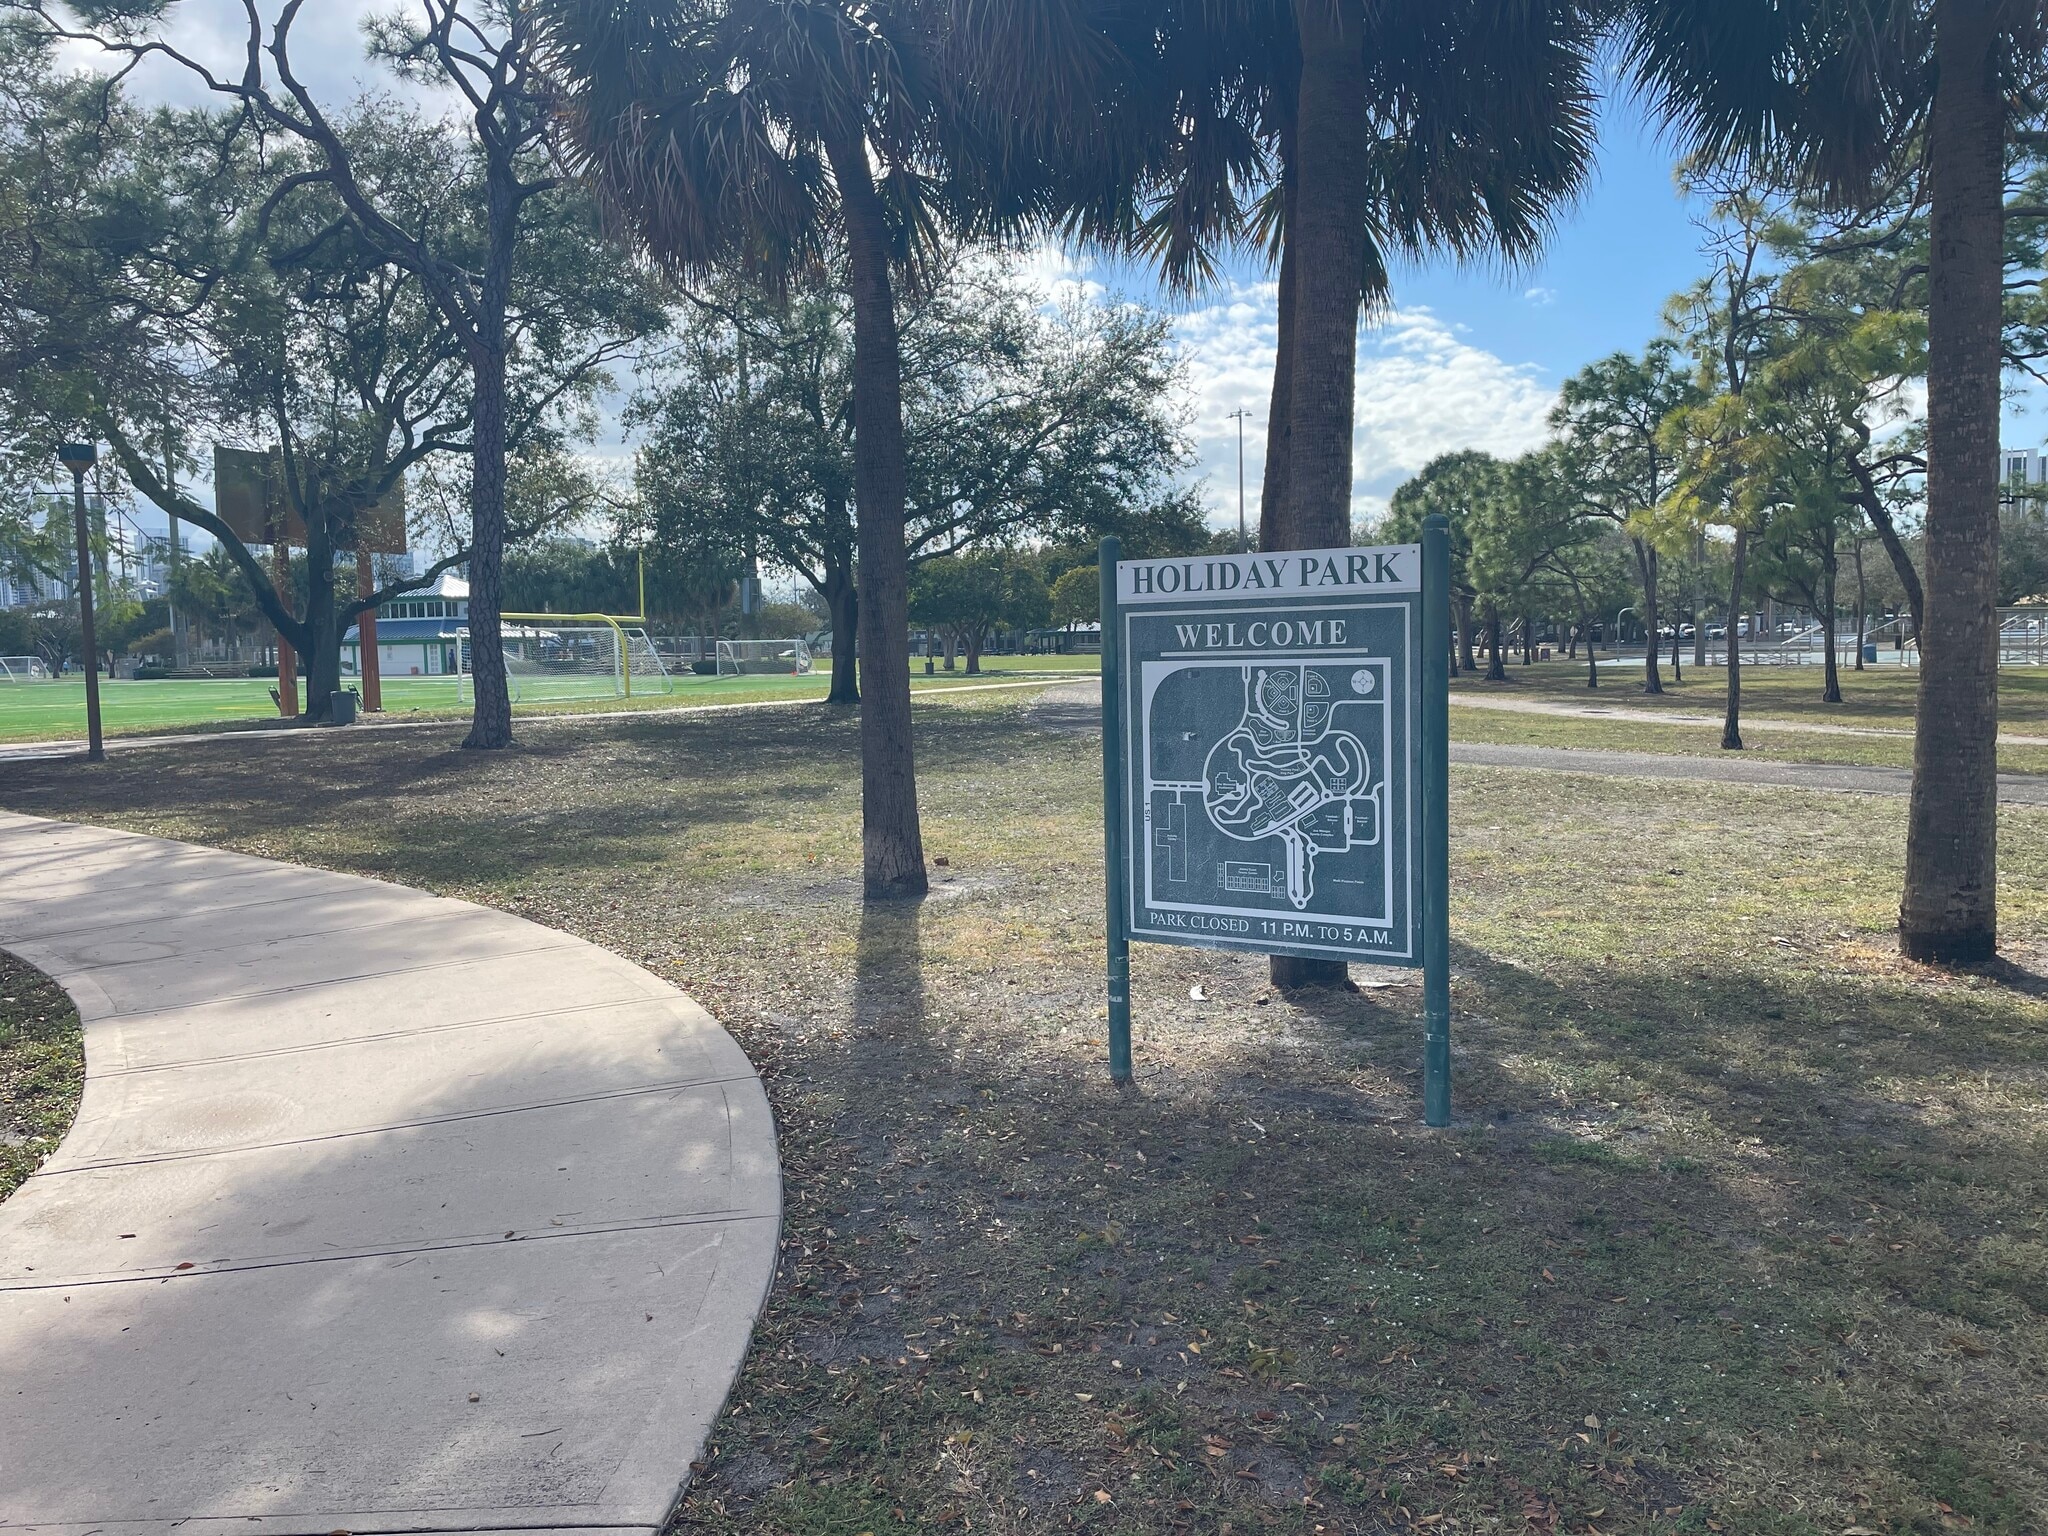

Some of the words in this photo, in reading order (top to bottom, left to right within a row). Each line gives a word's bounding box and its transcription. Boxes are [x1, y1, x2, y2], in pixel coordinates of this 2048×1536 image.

[1132, 558, 1288, 594] HOLIDAY
[1298, 552, 1402, 587] PARK
[1175, 619, 1348, 648] WELCOME
[1144, 810, 1151, 822] US
[1149, 912, 1187, 927] PARK
[1190, 916, 1250, 932] CLOSED
[1260, 921, 1277, 935] 11
[1283, 922, 1314, 938] P.M.
[1317, 926, 1340, 941] TO
[1343, 927, 1353, 941] 5
[1357, 930, 1393, 945] A.M.
